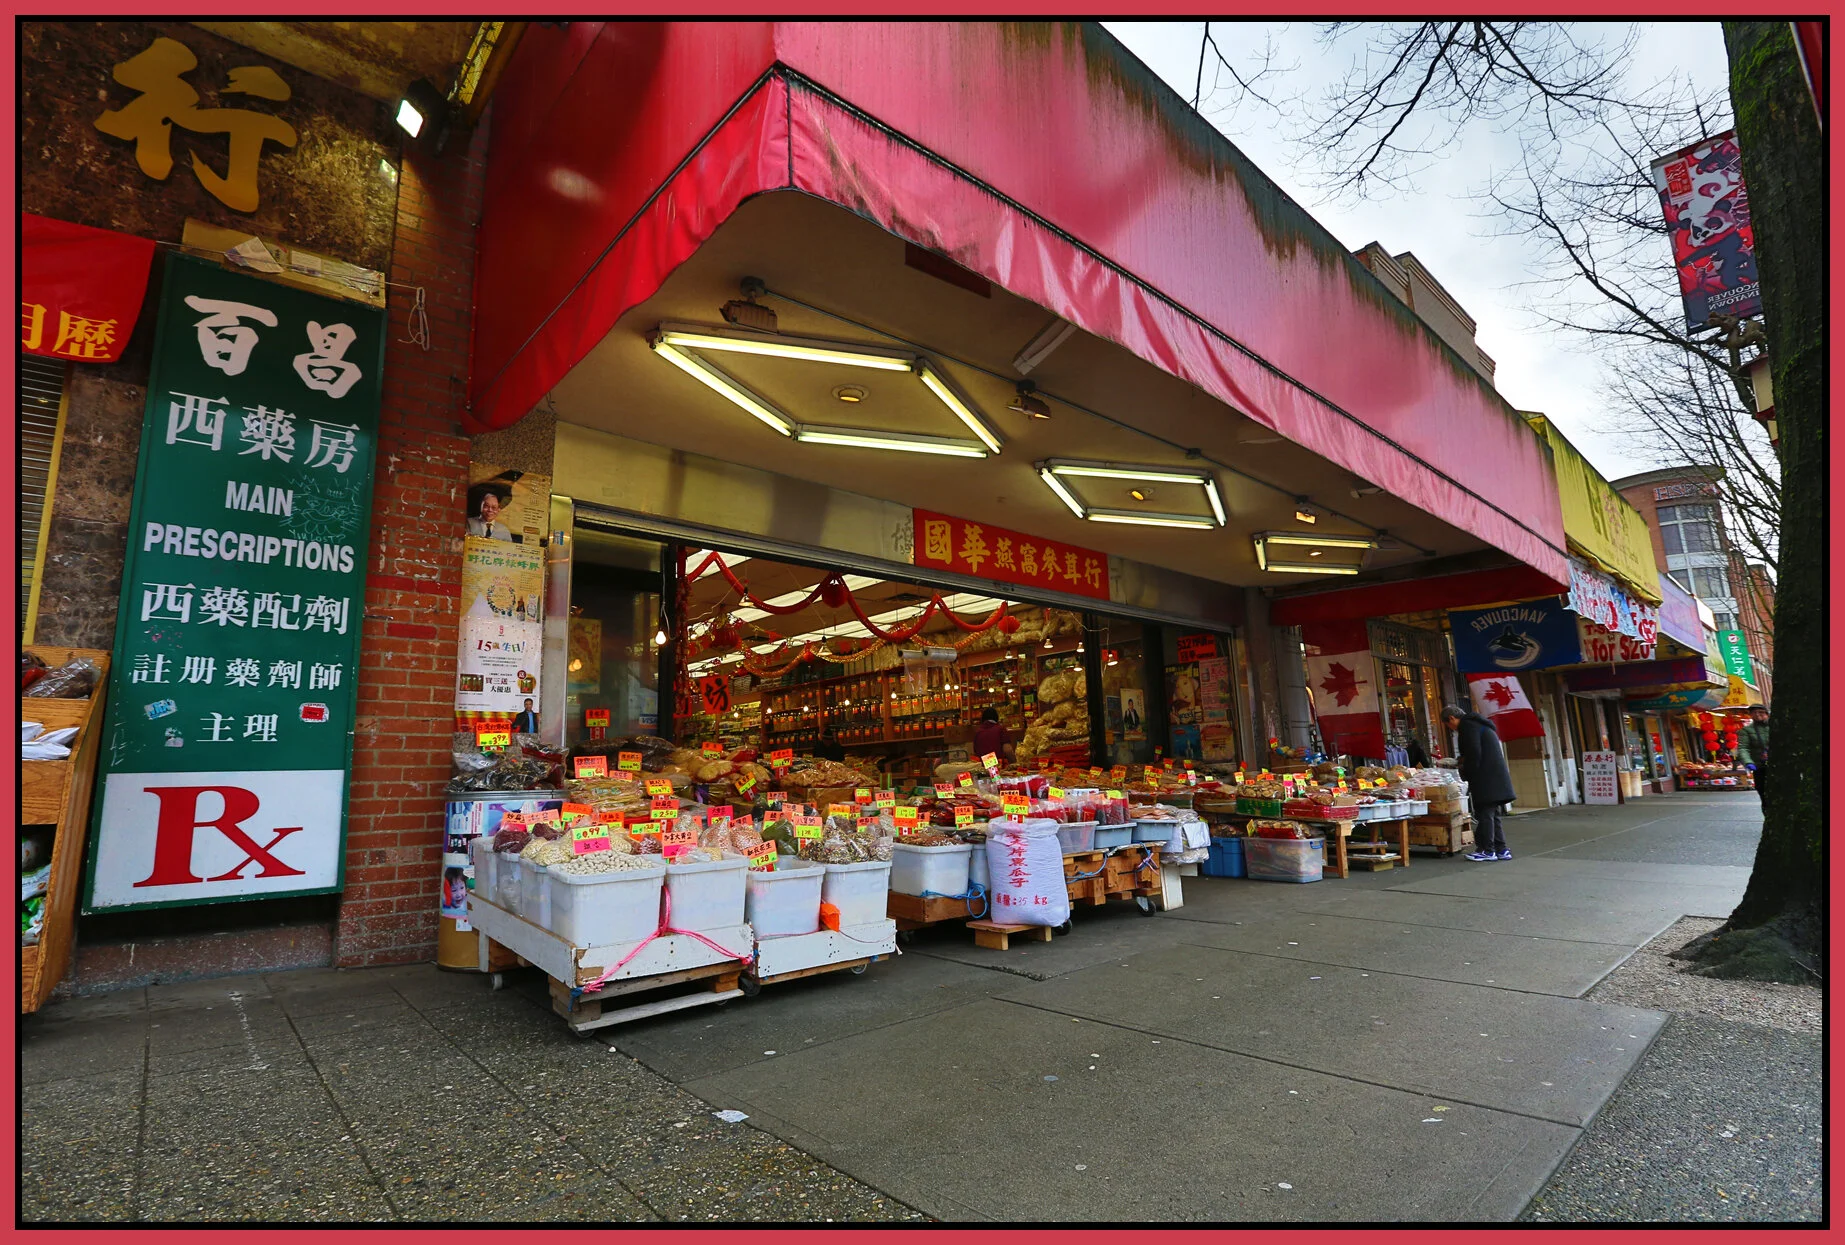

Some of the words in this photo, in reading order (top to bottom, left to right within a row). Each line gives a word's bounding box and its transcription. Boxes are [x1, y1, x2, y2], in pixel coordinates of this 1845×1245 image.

[94, 37, 297, 212] 行
[166, 390, 360, 474] 西藥房
[225, 480, 294, 517] MAIN
[144, 523, 354, 573] PRESCRIPTIONS
[140, 582, 349, 634] 西藥配劑
[1592, 638, 1615, 662] for
[197, 712, 278, 743] 主理
